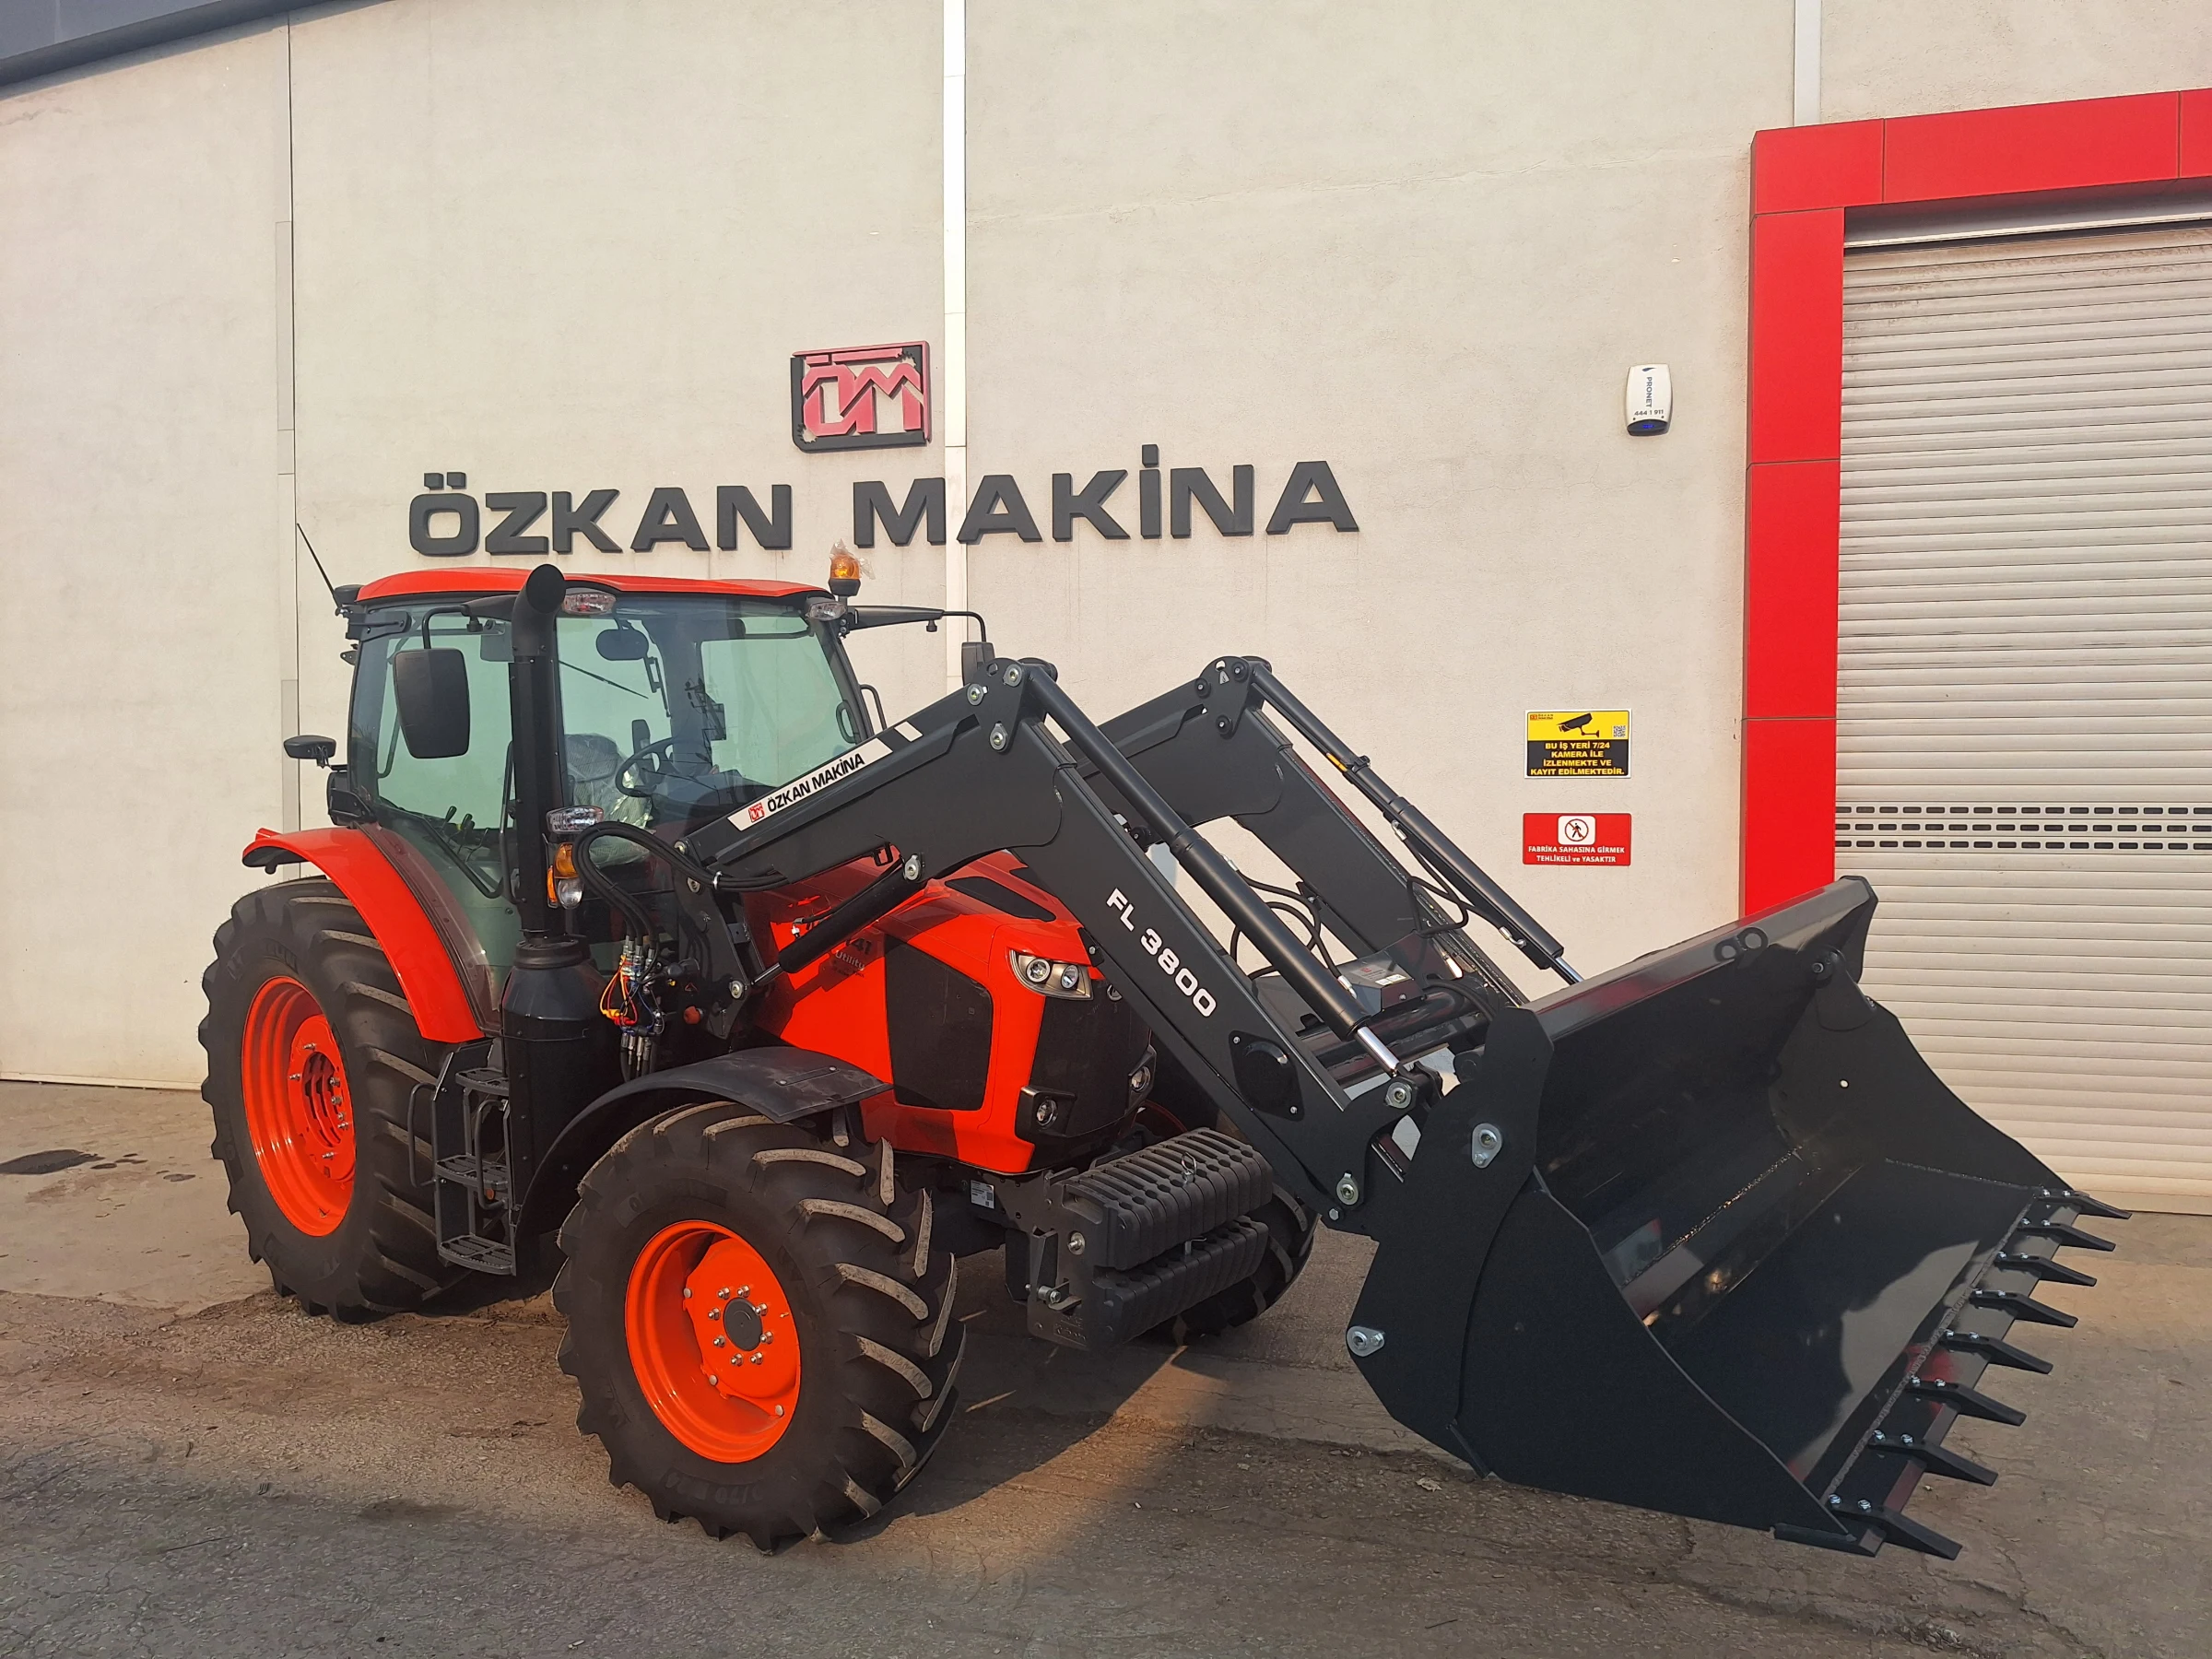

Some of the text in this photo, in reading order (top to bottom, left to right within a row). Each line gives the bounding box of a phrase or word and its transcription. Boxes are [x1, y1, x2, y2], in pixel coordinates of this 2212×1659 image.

[409, 443, 1359, 557] ÖZKAN MAKİNA
[1559, 741, 1568, 750] İŞ
[1570, 740, 1591, 749] YERİ
[1592, 741, 1610, 749] 7/24
[1590, 749, 1604, 758] İLE
[1543, 759, 1598, 767] İZLENMEKTE
[1558, 767, 1625, 775] EDİLMEKTEDİR.
[767, 782, 811, 813] ÖZKAN
[812, 753, 865, 790] MAKİNA
[1597, 845, 1625, 853] GİRMEK
[1106, 888, 1217, 1018] FL 3800
